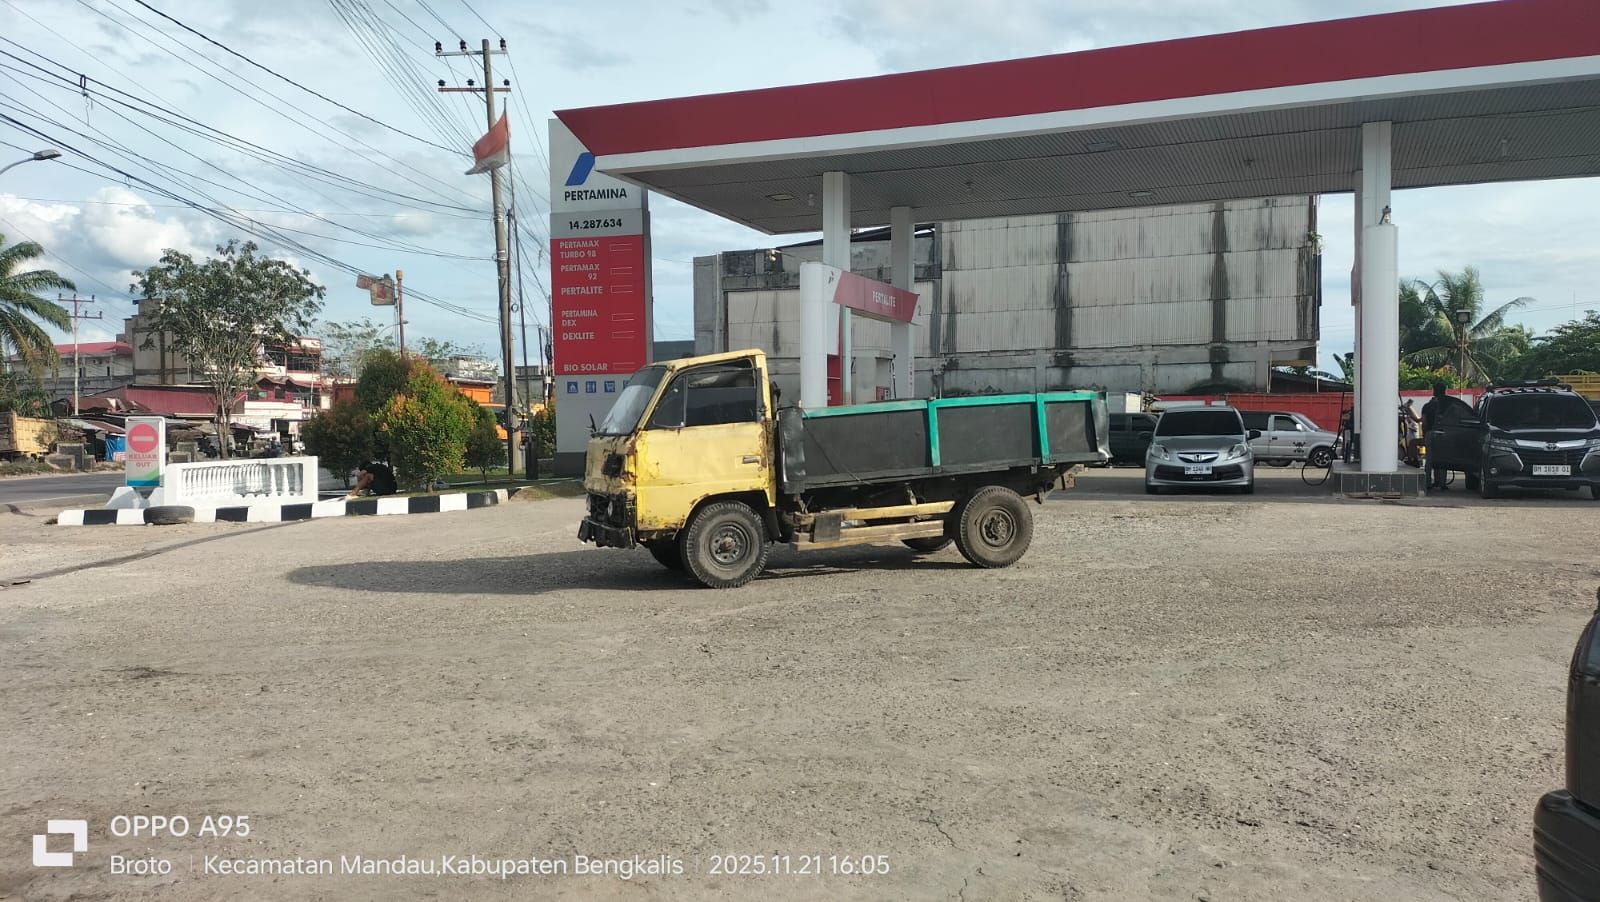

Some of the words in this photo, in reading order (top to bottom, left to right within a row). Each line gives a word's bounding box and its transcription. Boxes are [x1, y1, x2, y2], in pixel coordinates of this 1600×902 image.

[564, 188, 627, 201] PERTAMINA
[569, 218, 622, 230] 14.287.634
[560, 240, 600, 249] PERTAMAX
[560, 250, 585, 259] TURBO
[560, 263, 600, 272] PERTAMAX
[587, 273, 597, 281] 92
[561, 286, 603, 296] PERTALITE
[872, 291, 896, 307] PERTALITE
[561, 310, 598, 318] PERTAMINA
[561, 319, 577, 327] DEX
[562, 332, 595, 340] DEXLITE
[563, 363, 579, 372] BIO
[580, 362, 608, 372] SOLAR
